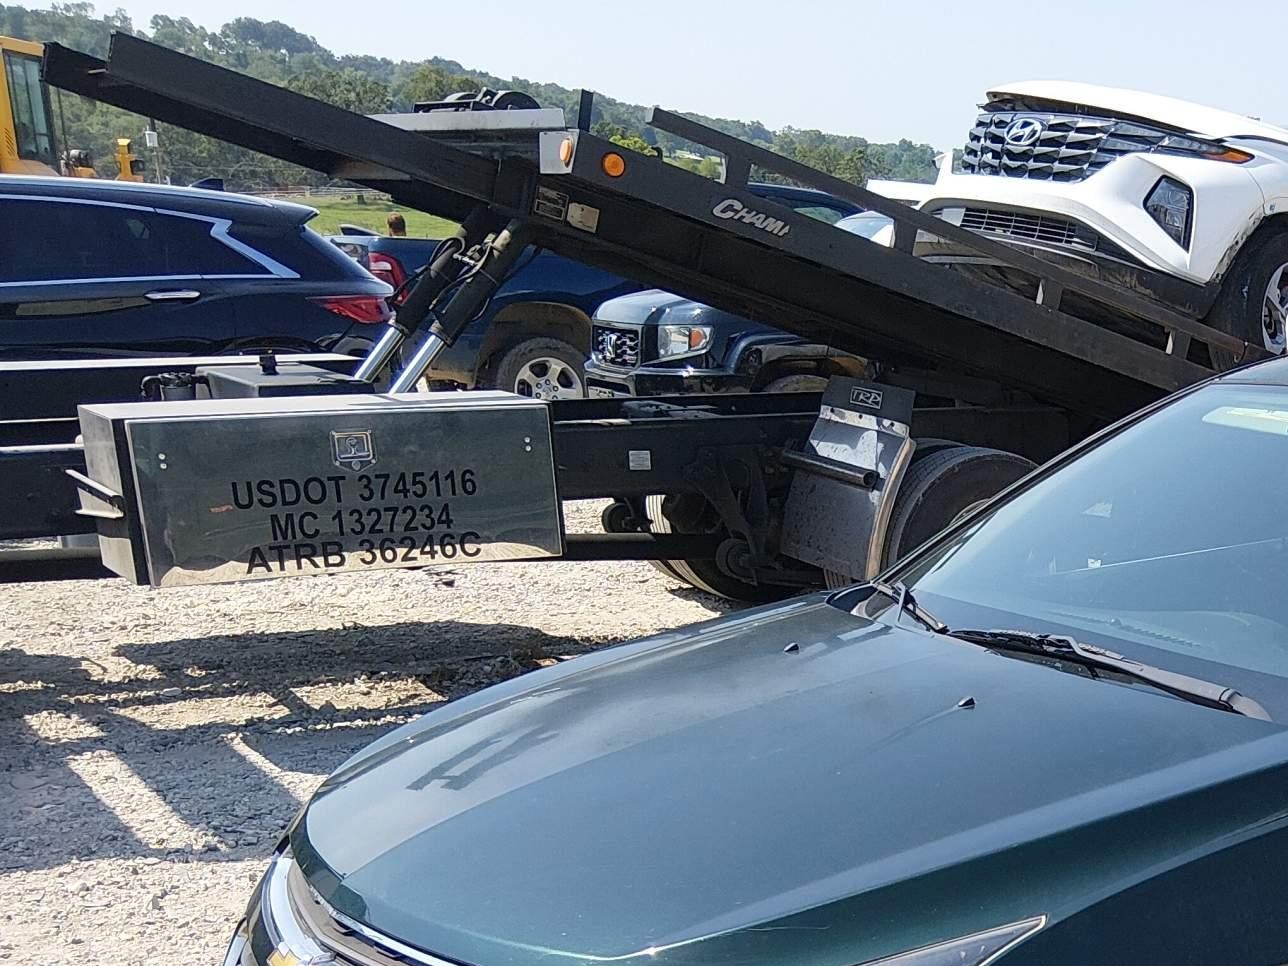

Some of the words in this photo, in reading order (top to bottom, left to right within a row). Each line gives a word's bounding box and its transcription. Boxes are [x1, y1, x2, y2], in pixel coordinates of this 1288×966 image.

[231, 475, 346, 510] USDOT
[357, 469, 477, 501] 3745116
[270, 511, 320, 541] MC
[331, 503, 453, 537] 1327234
[246, 540, 346, 575] ATRB
[359, 531, 482, 565] 36246C
